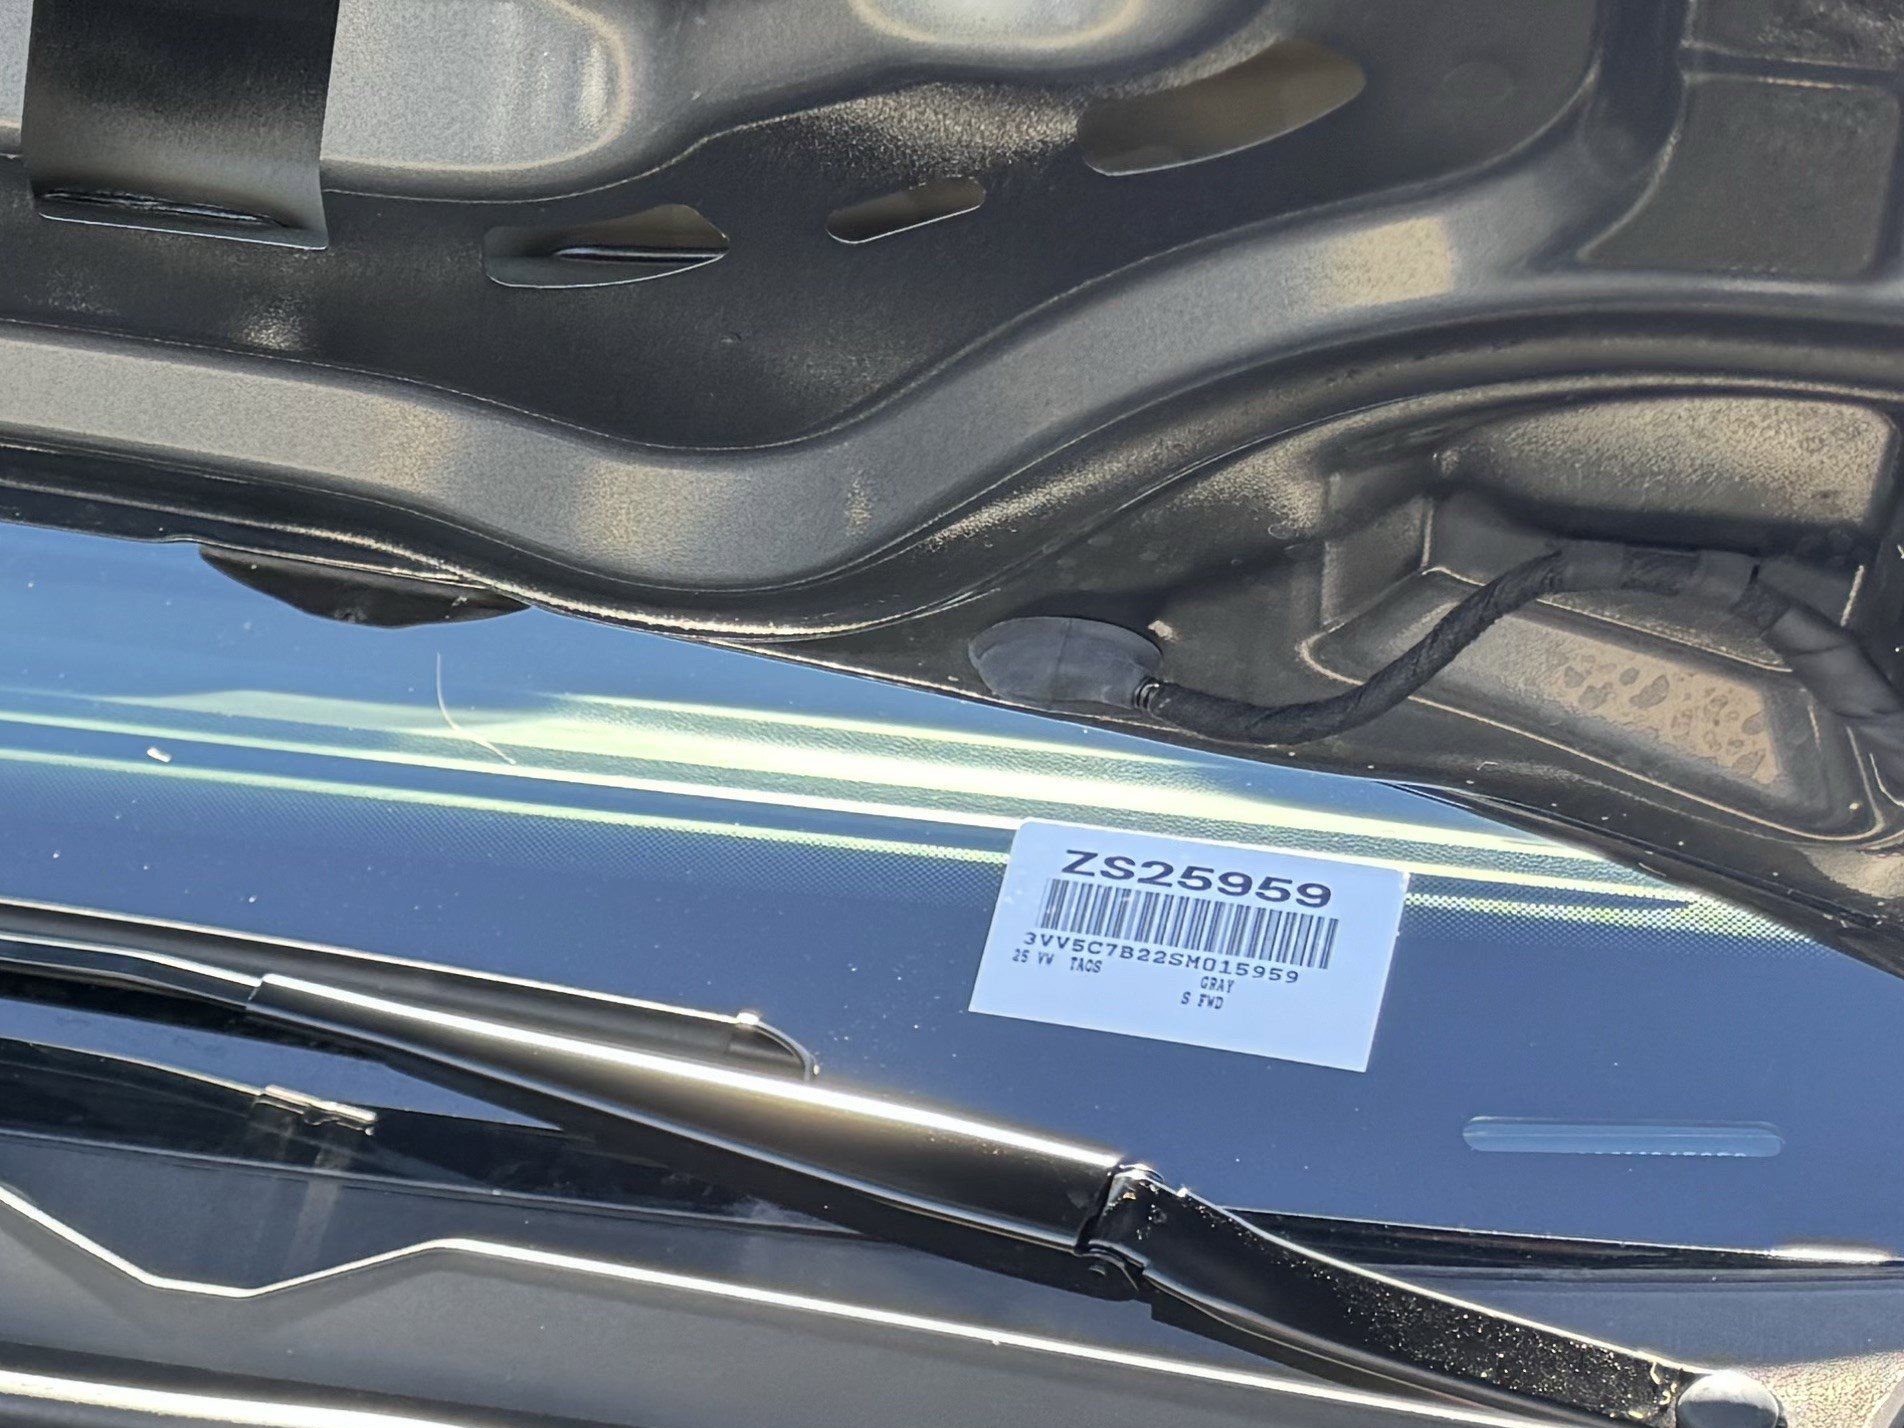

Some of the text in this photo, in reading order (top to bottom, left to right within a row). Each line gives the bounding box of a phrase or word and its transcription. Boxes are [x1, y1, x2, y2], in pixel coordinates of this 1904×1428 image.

[1059, 848, 1334, 910] ZS25959
[1021, 930, 1301, 985] 3VV5C7B22SM015959
[1196, 992, 1225, 1011] FWD
[1198, 975, 1236, 994] GRAY
